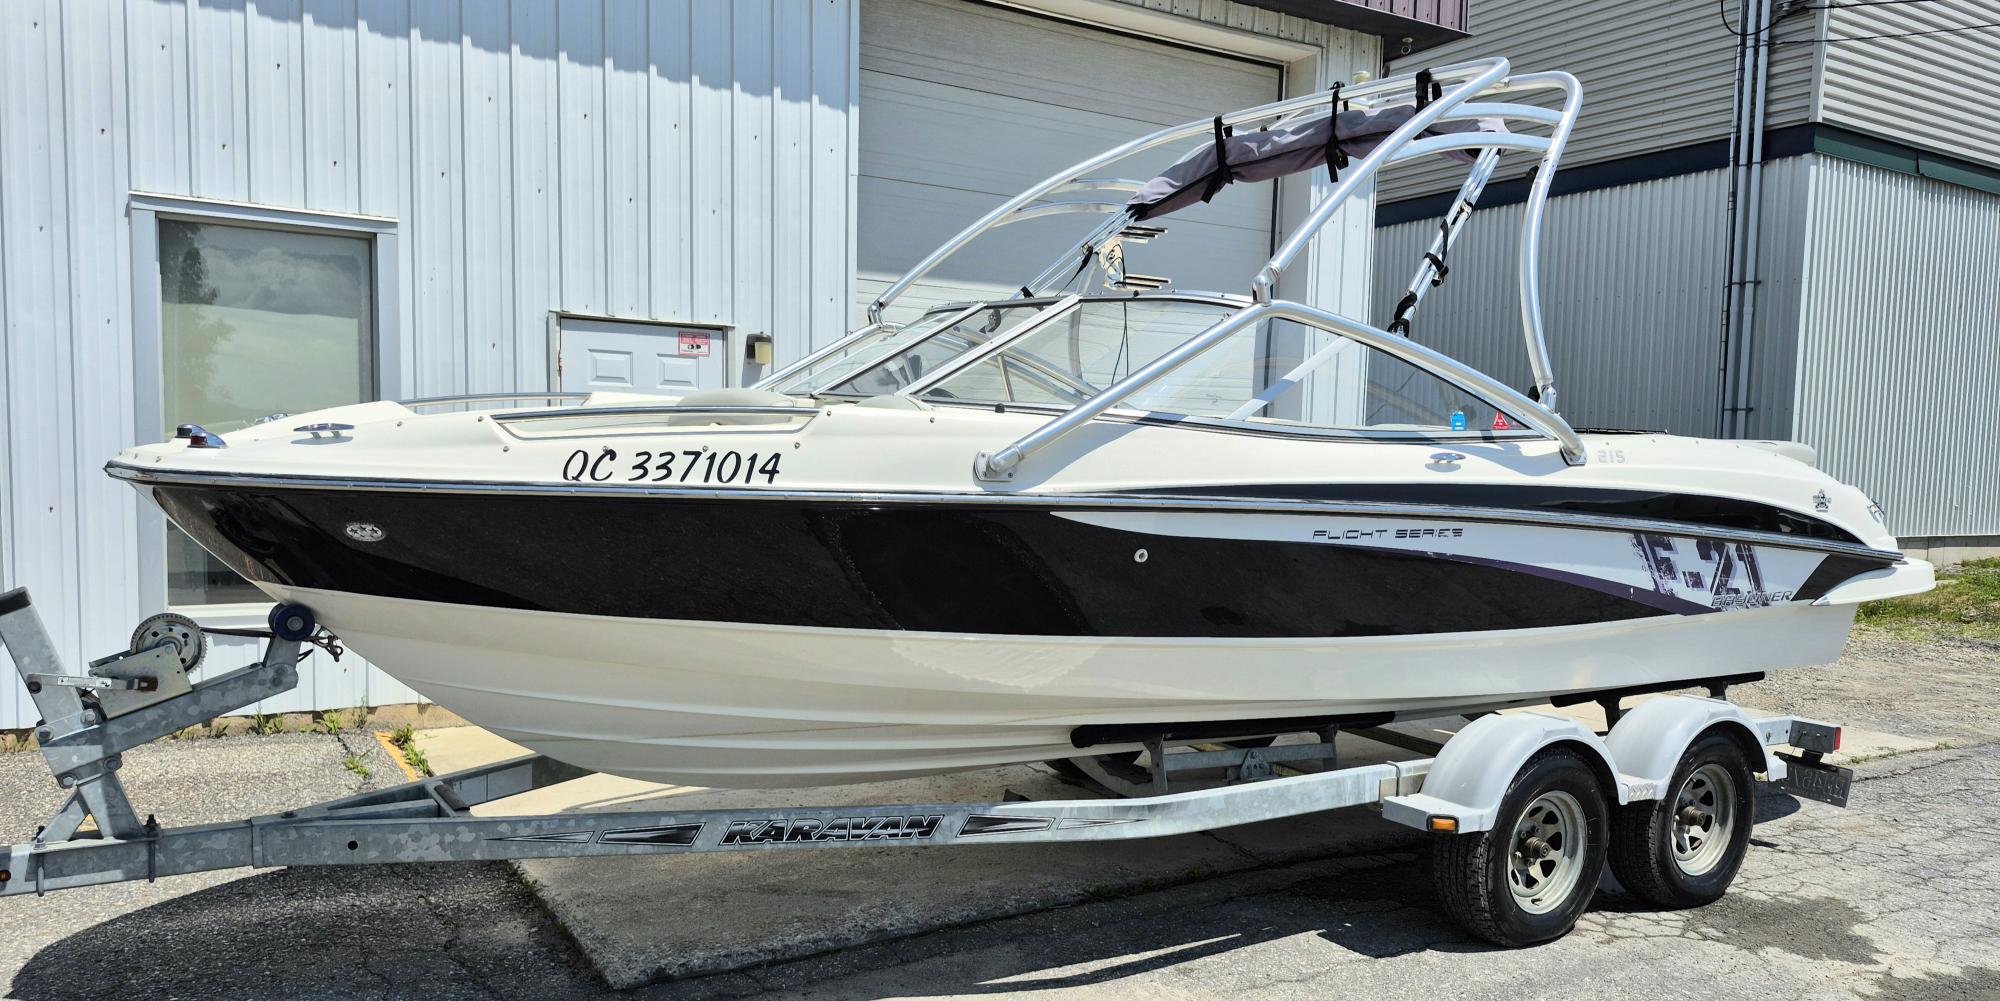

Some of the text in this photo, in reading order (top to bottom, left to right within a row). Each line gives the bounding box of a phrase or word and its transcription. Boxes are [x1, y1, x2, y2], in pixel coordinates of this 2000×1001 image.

[562, 449, 782, 485] QC 3371014
[1597, 450, 1626, 464] 215
[1312, 528, 1464, 540] FLIGHT SERIES
[718, 814, 946, 846] KARAVAN
